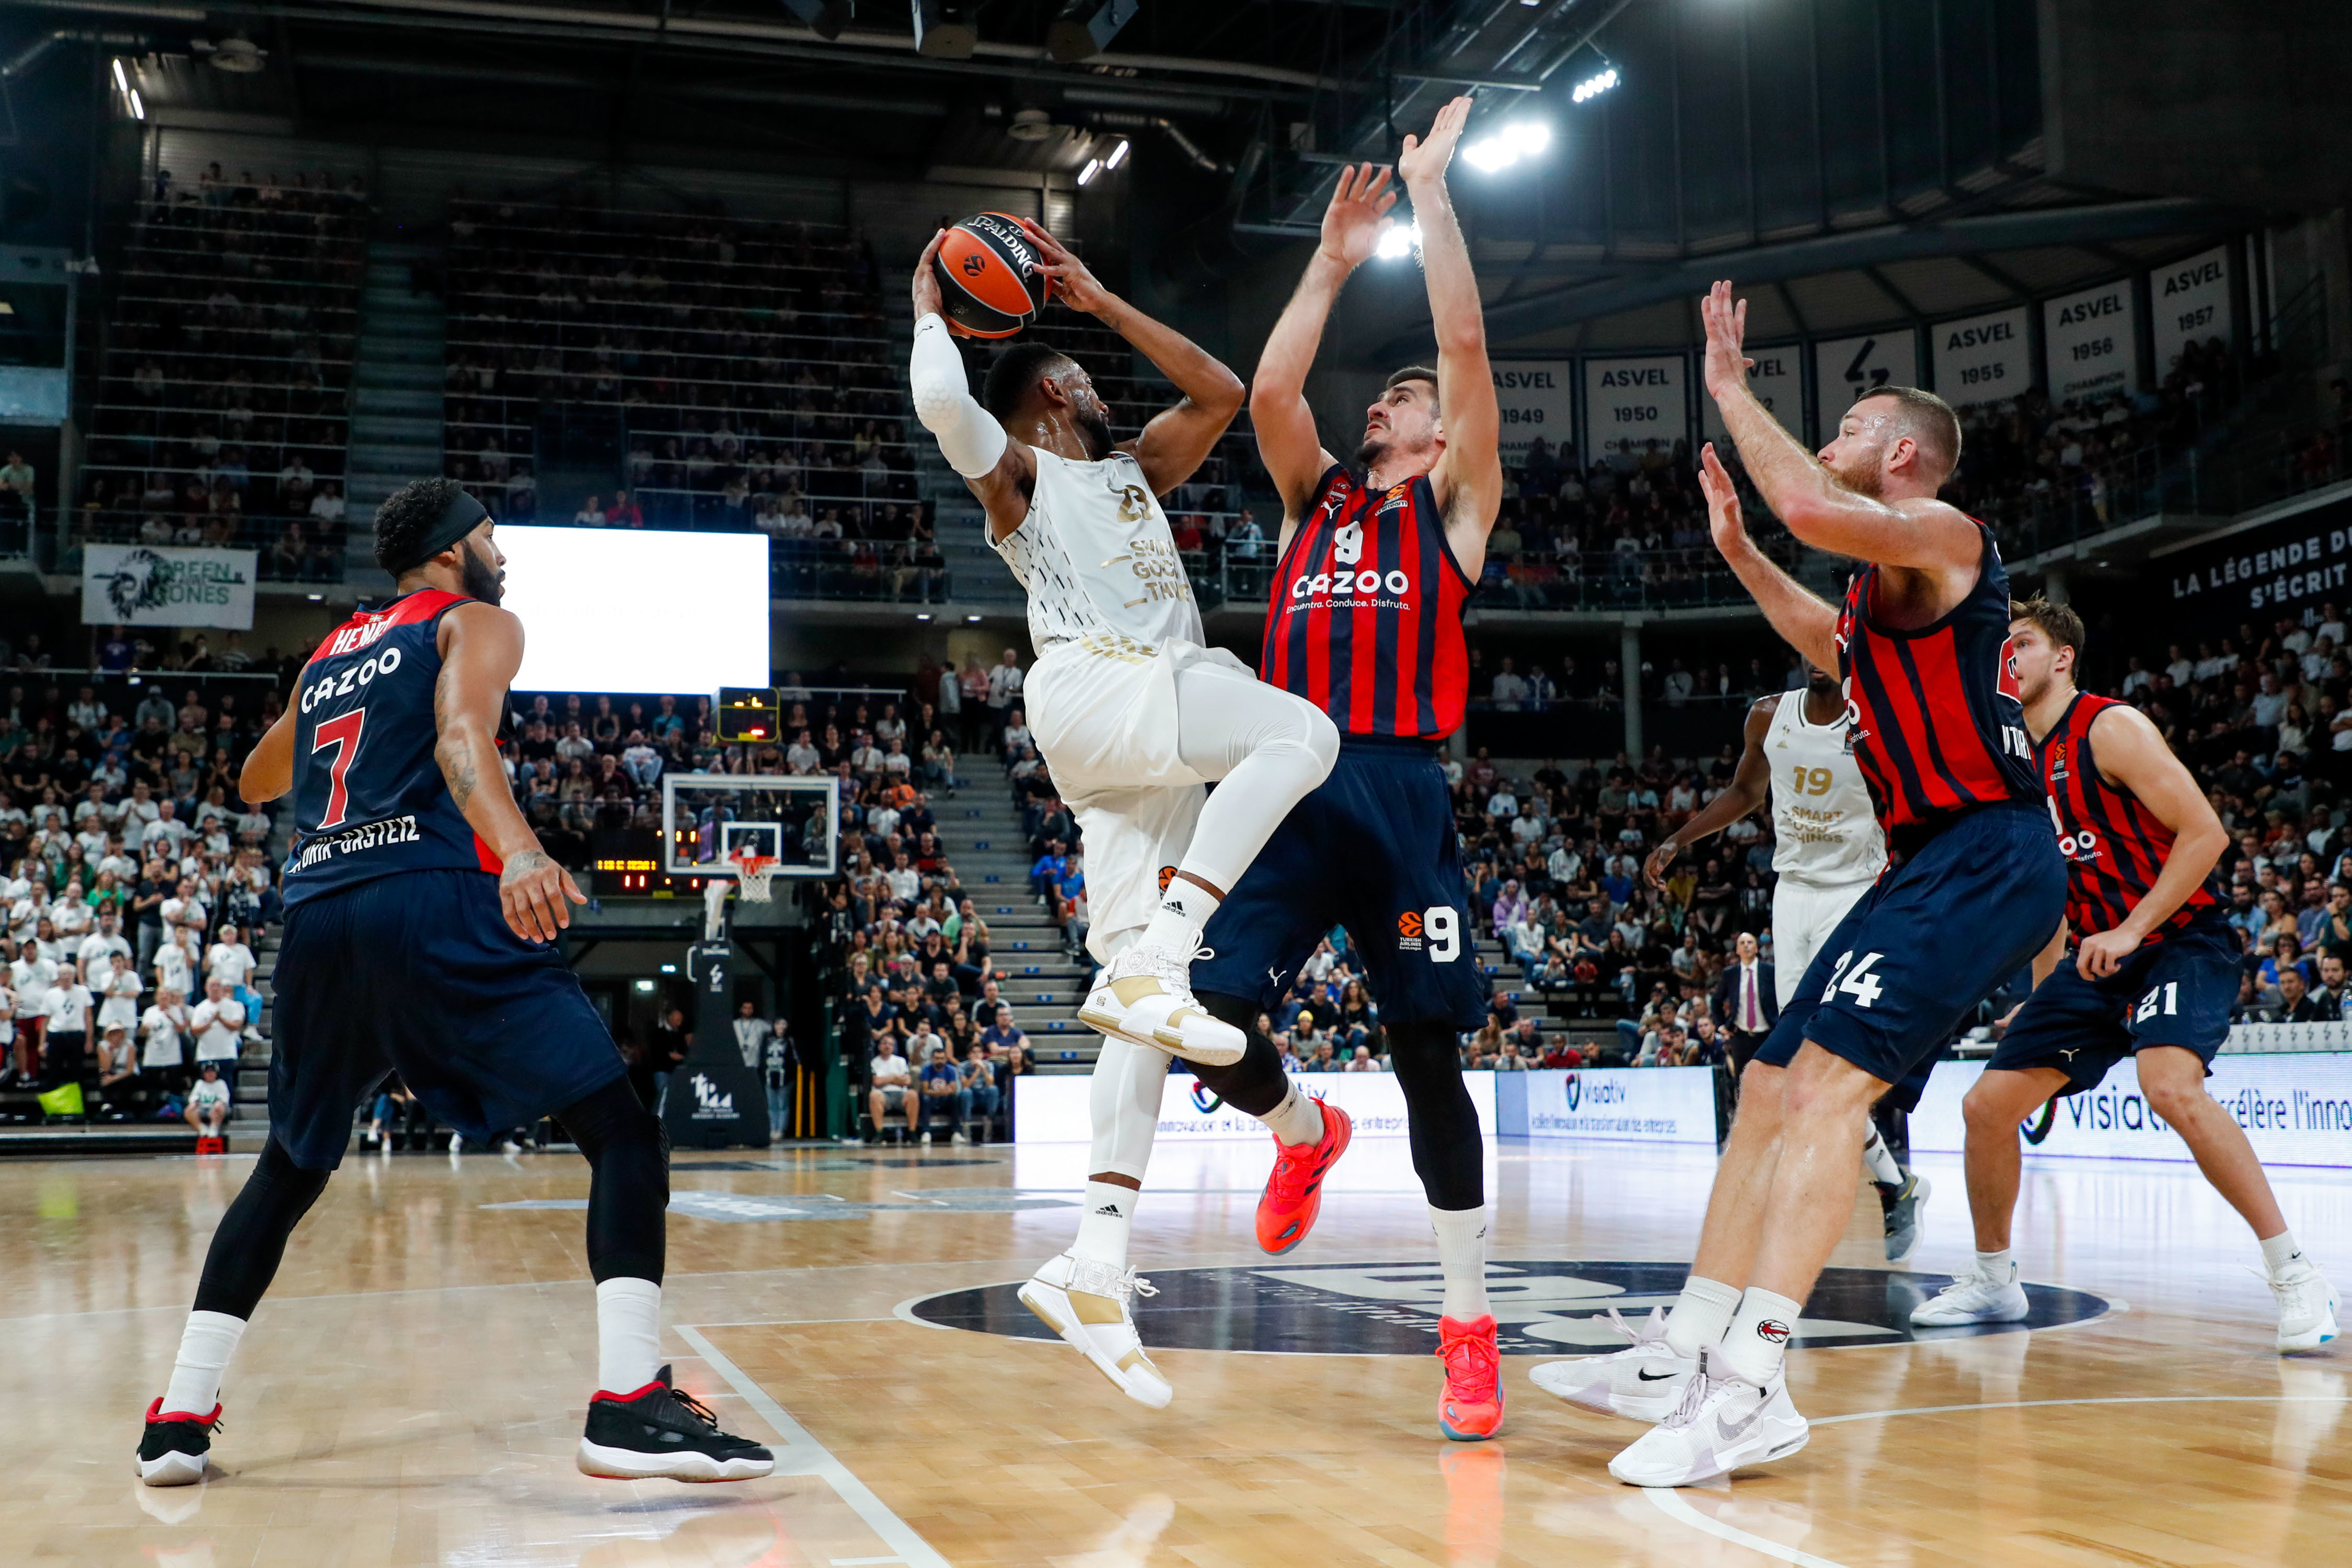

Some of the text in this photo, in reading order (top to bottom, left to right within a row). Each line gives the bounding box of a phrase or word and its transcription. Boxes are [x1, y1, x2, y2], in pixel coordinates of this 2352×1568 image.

[967, 216, 1035, 279] SPALDING
[2164, 261, 2223, 297] ASVEL
[2059, 294, 2123, 327] ASVEL
[1947, 322, 2015, 351] ASVEL
[1493, 372, 1555, 389] ASVEL
[1601, 368, 1669, 387] ASVEL
[1961, 362, 2004, 385] 1955
[1502, 409, 1544, 424] 1949
[1615, 406, 1657, 422] 1950
[1334, 521, 1363, 564] 9
[2173, 573, 2201, 598] LA
[2210, 536, 2321, 588] LÉGENDE
[1293, 570, 1409, 598] CAZOO
[2250, 562, 2347, 608] S'ÉCRIT
[1286, 599, 1410, 614] Encuentra. Conduce. Disfruta.
[301, 648, 401, 714] CAZOO
[1851, 730, 1871, 743] isfruta.
[312, 707, 365, 831] 7
[1793, 766, 1833, 796] 19
[1162, 903, 1186, 917] adidas
[1424, 906, 1460, 963] 9
[1819, 950, 1885, 1008] 24
[2136, 982, 2177, 1024] 21
[2066, 1085, 2167, 1130] visia
[1096, 1208, 1123, 1218] adidas
